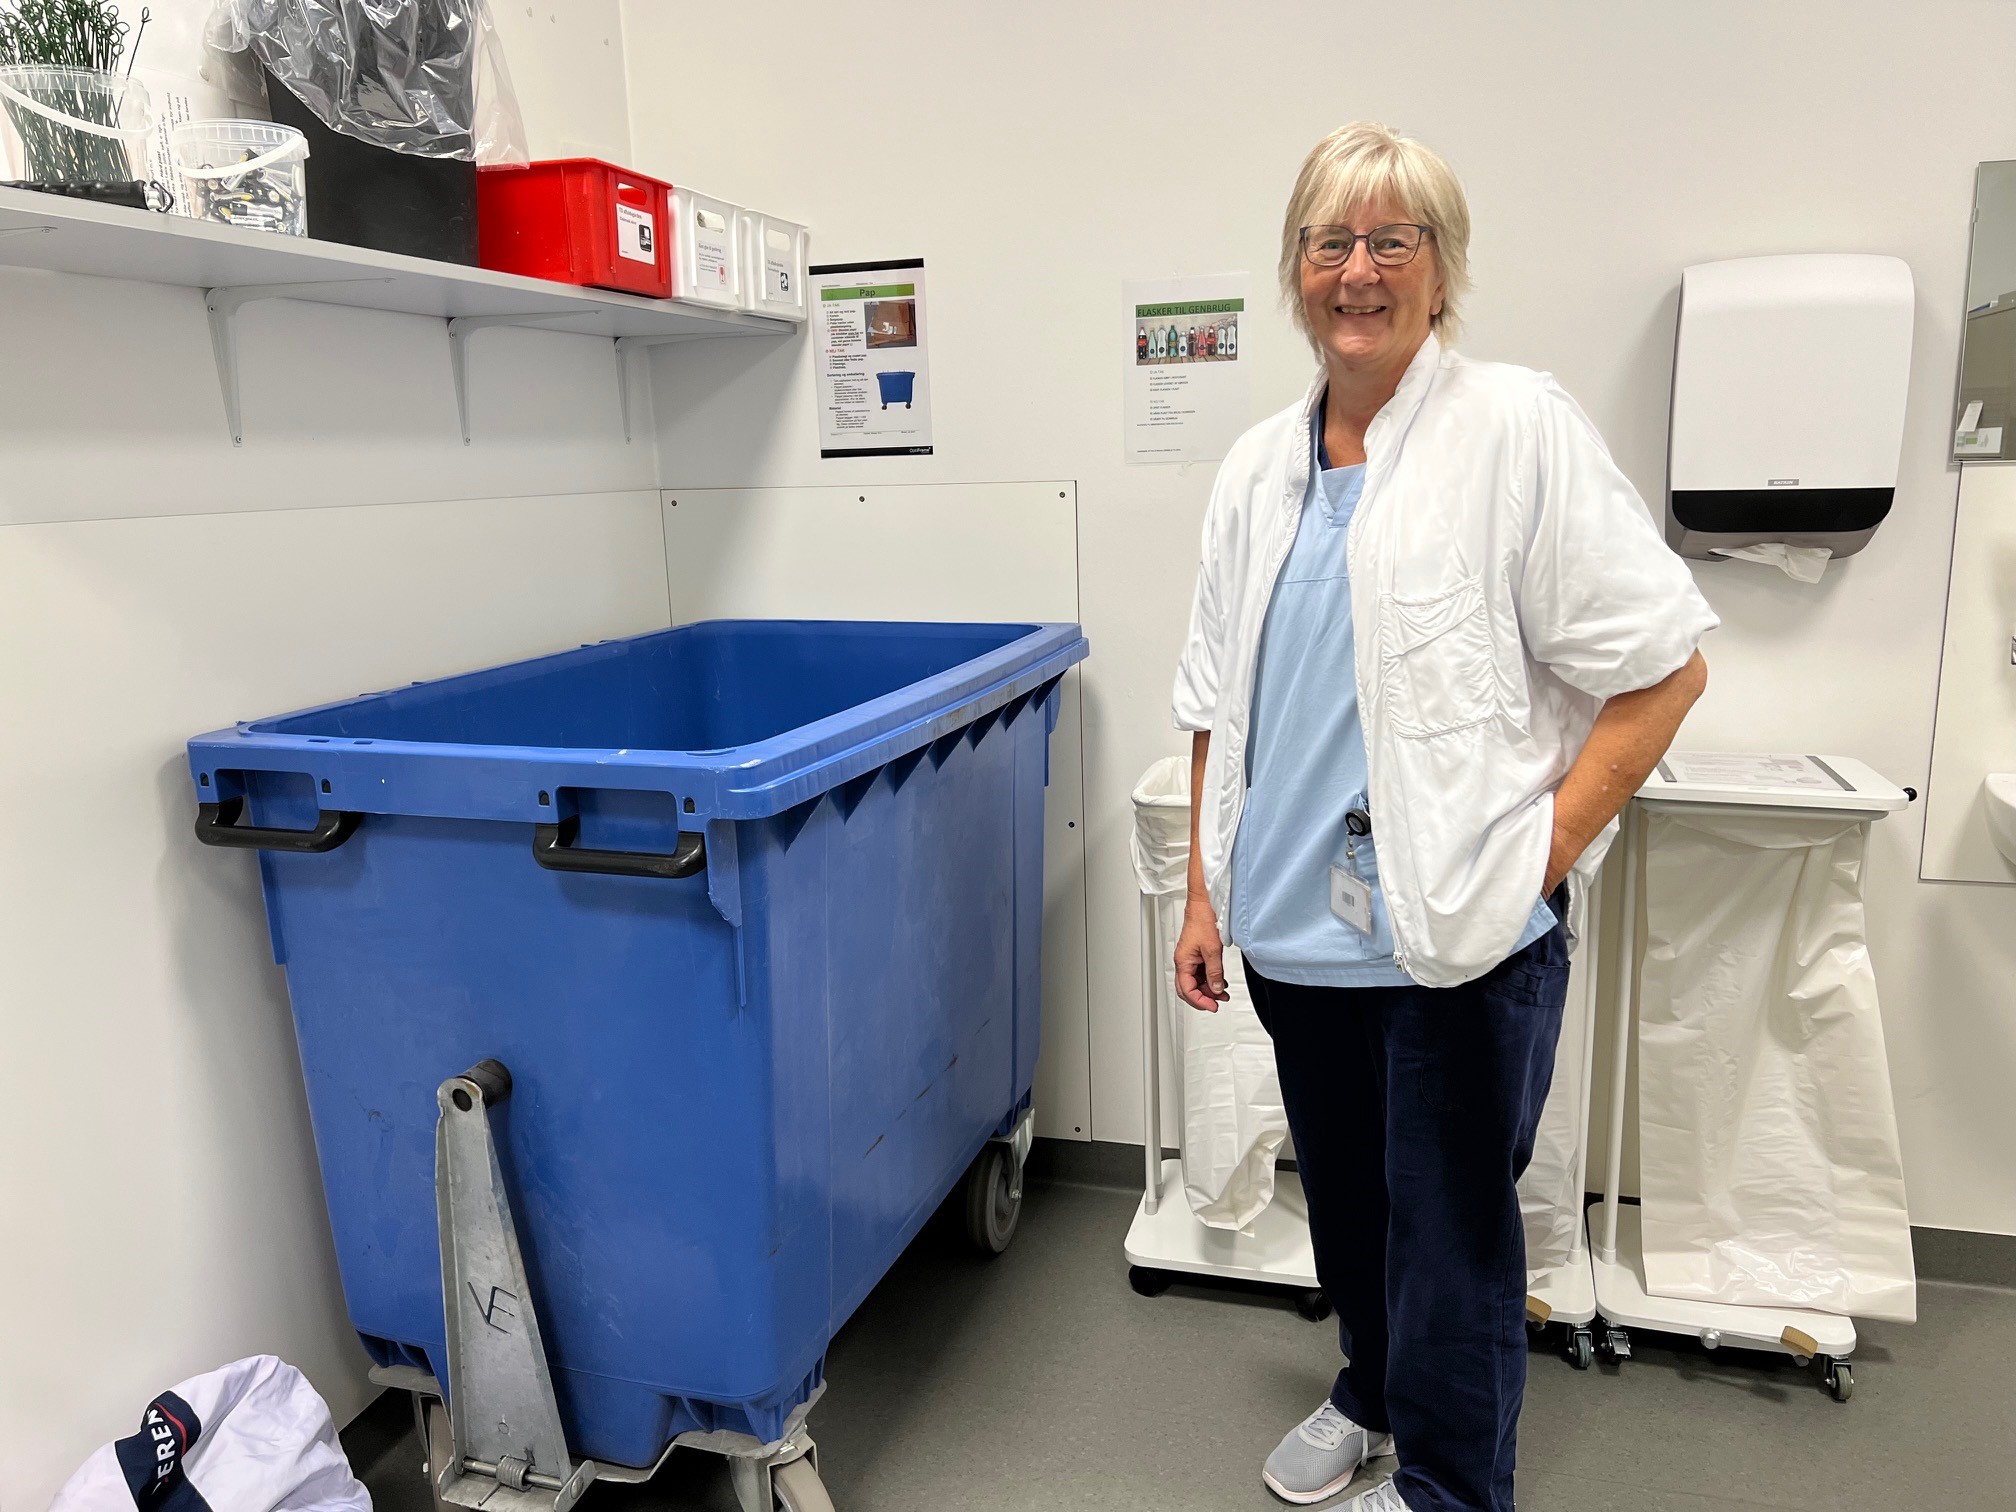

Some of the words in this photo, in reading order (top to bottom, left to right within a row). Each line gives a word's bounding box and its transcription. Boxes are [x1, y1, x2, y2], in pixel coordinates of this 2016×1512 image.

[860, 289, 876, 298] Pap
[1137, 307, 1172, 317] FLASKER
[1174, 306, 1187, 315] TIL
[1188, 303, 1231, 314] GENBRUG
